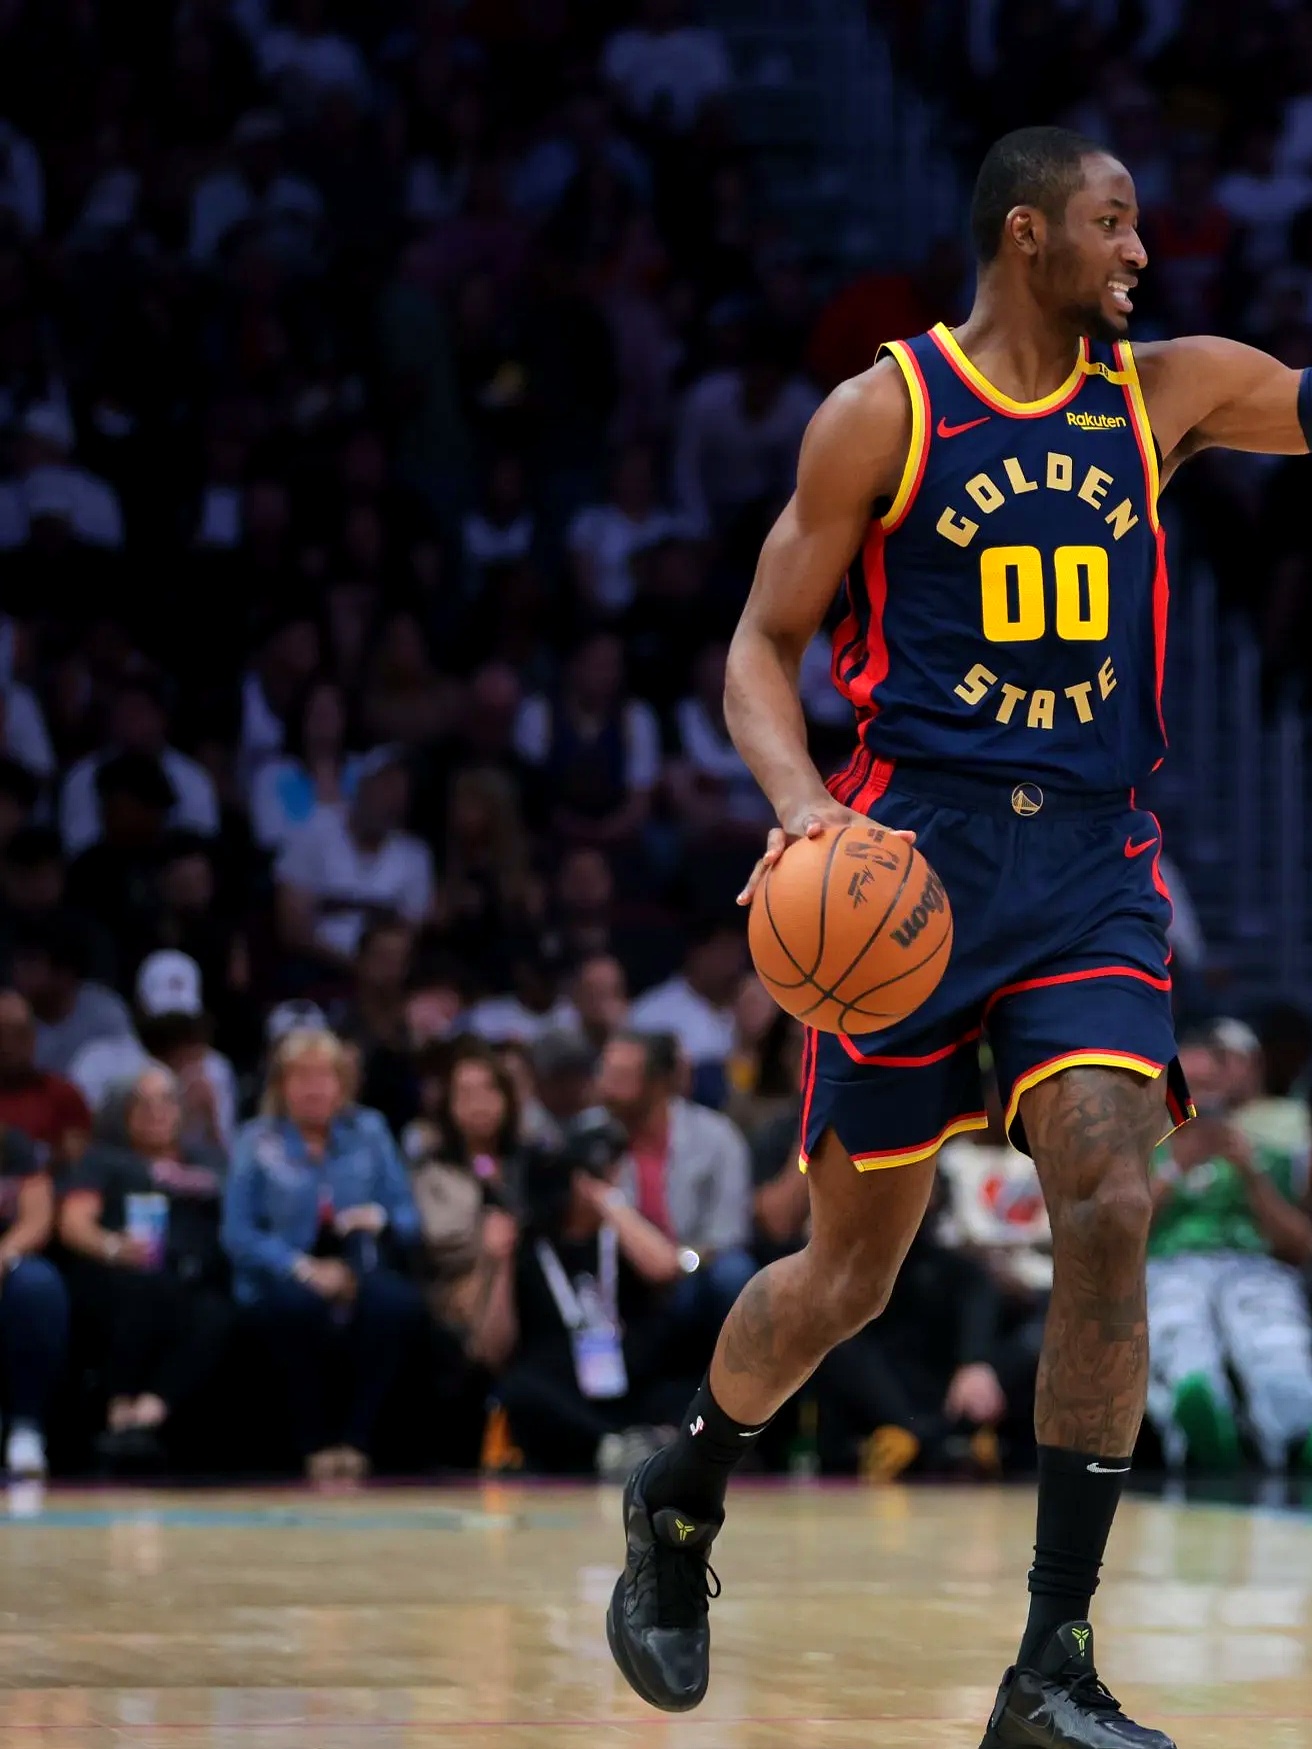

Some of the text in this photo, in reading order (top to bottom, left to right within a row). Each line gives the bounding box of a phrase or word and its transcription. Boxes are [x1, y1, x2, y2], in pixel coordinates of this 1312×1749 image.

[1066, 412, 1126, 430] Rakuten
[936, 451, 1139, 548] GOLDEN
[980, 545, 1109, 643] 00
[953, 656, 1118, 730] STATE
